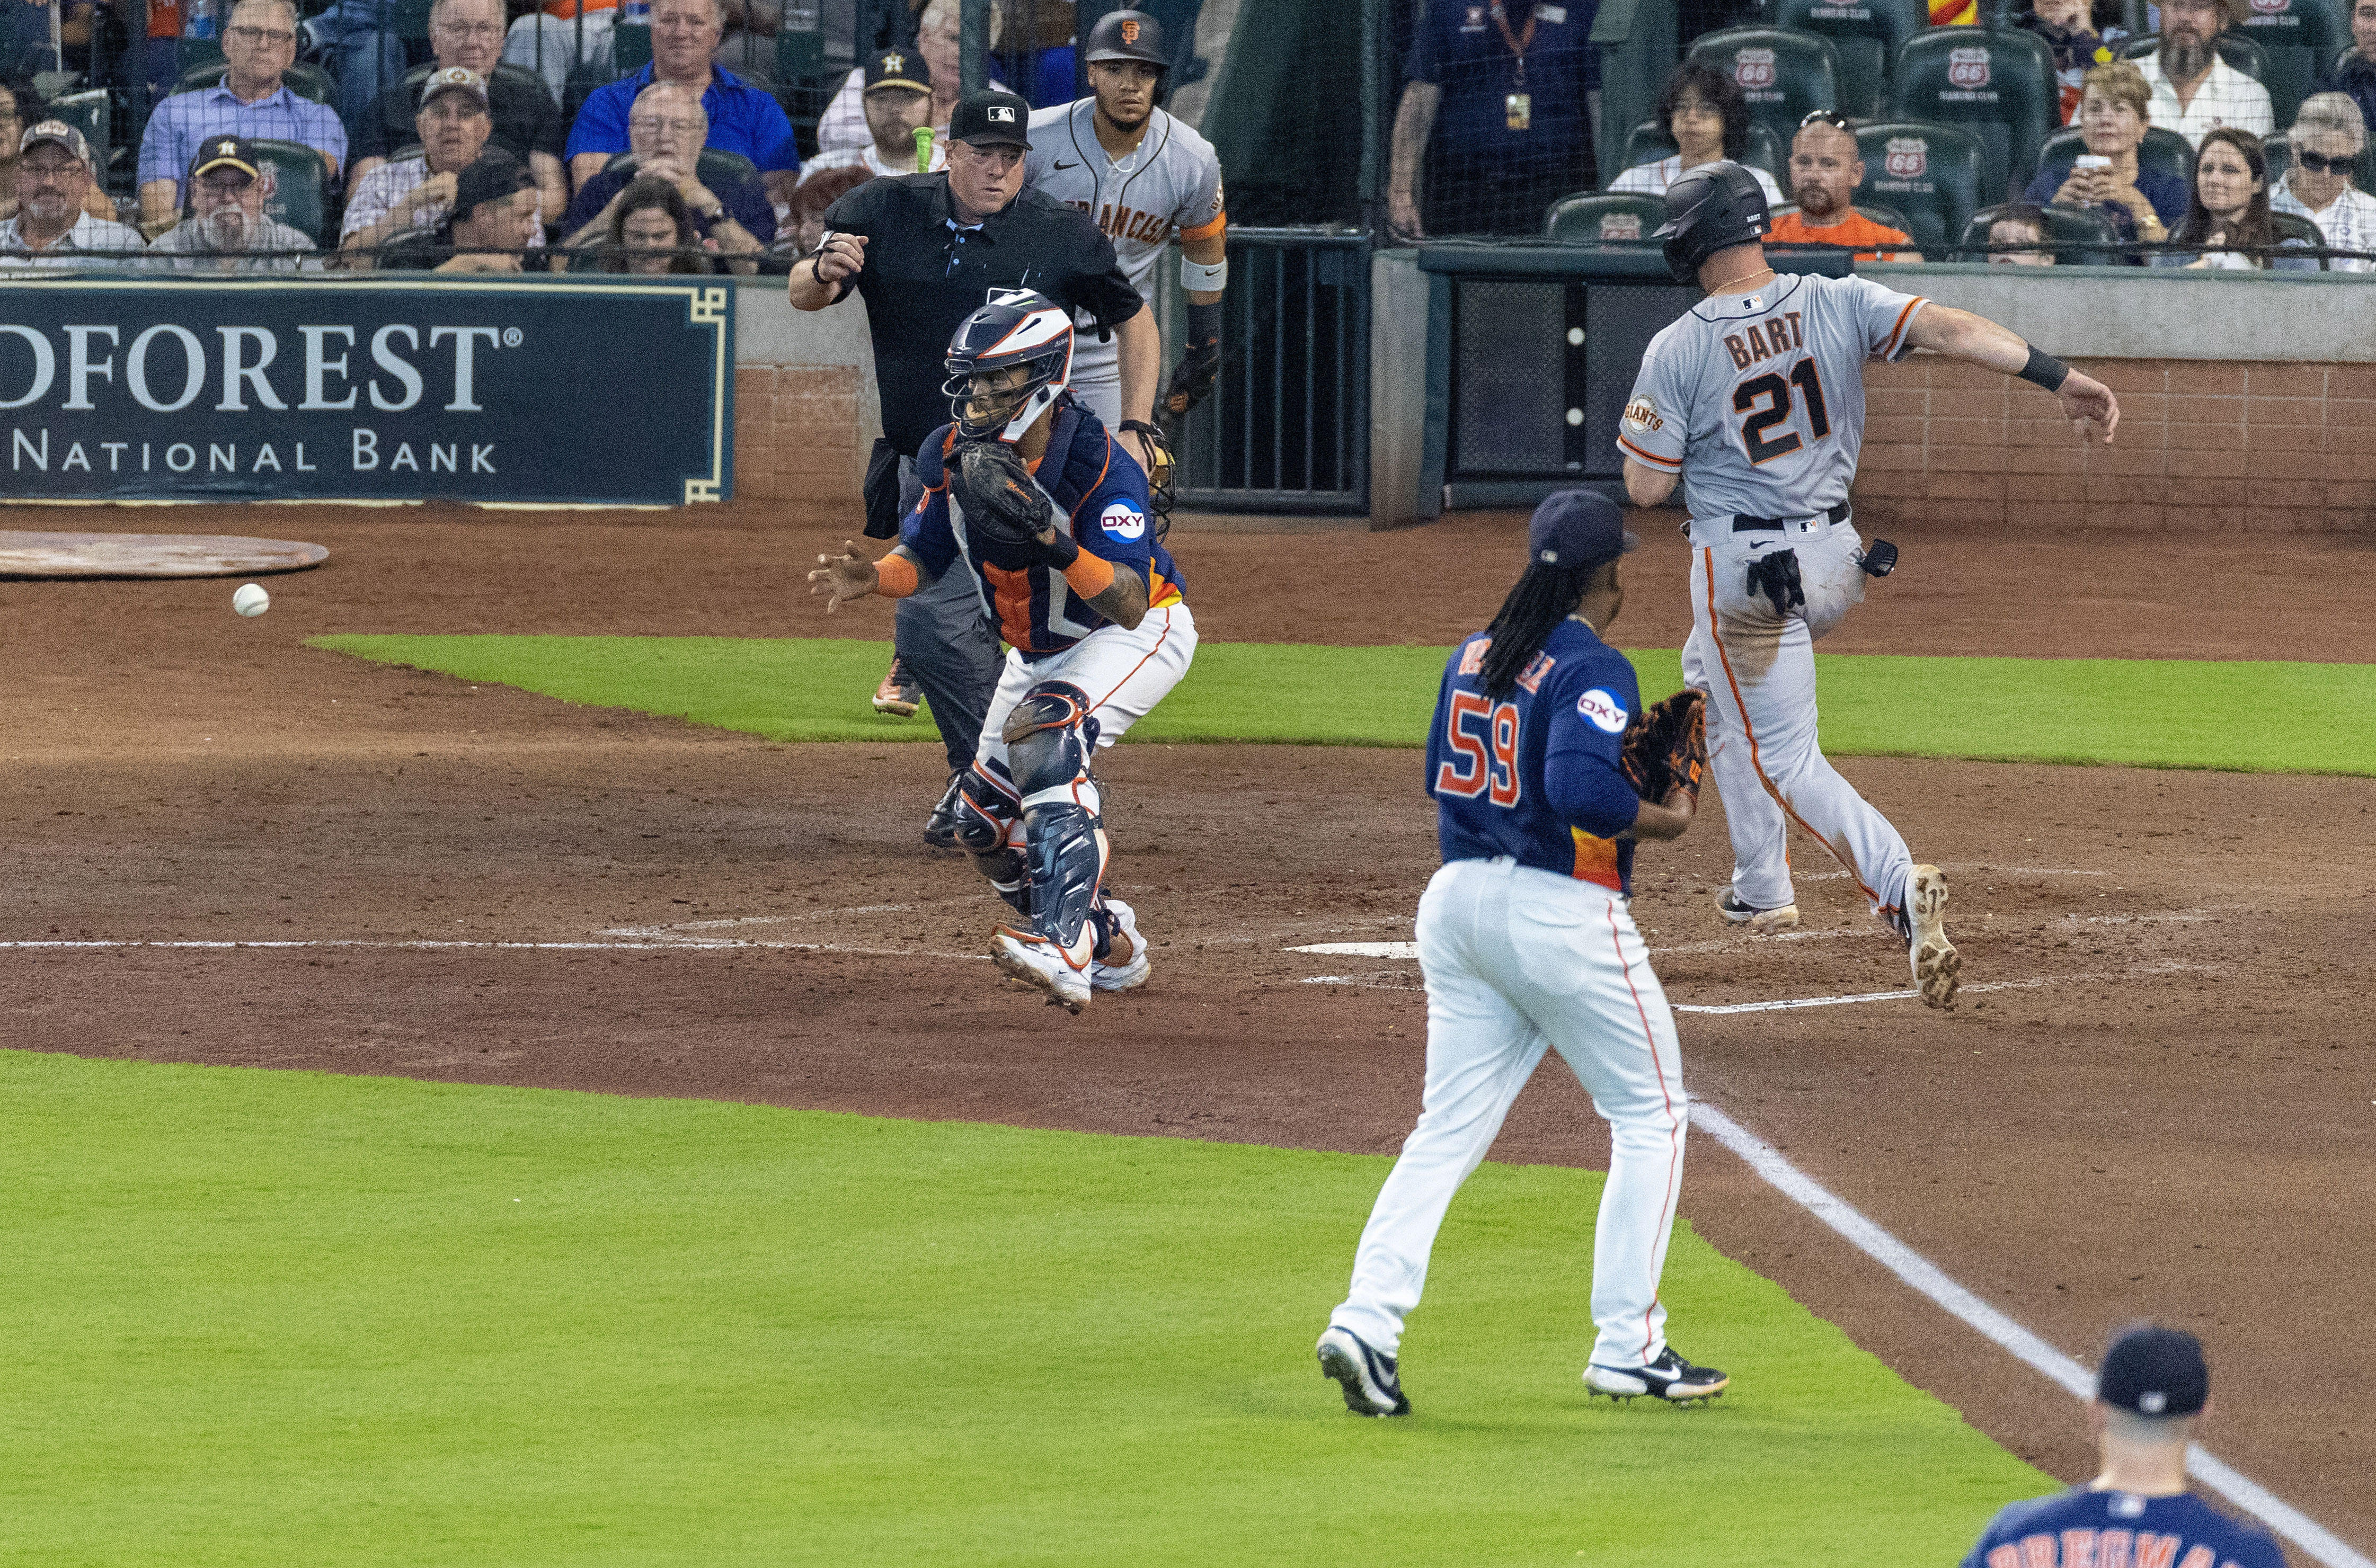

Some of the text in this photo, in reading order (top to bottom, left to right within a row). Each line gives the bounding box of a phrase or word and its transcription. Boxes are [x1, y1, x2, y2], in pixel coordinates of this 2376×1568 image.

[1742, 64, 1768, 81] 66
[1955, 64, 1981, 81] 66
[1892, 154, 1918, 171] 66
[1724, 311, 1803, 370] BART
[1624, 404, 1663, 431] GIANTS
[1732, 356, 1831, 466] 21
[12, 428, 497, 473] NATIONAL BANK
[1102, 515, 1143, 527] OXY
[1581, 698, 1625, 724] OXY
[1434, 689, 1521, 808] 59
